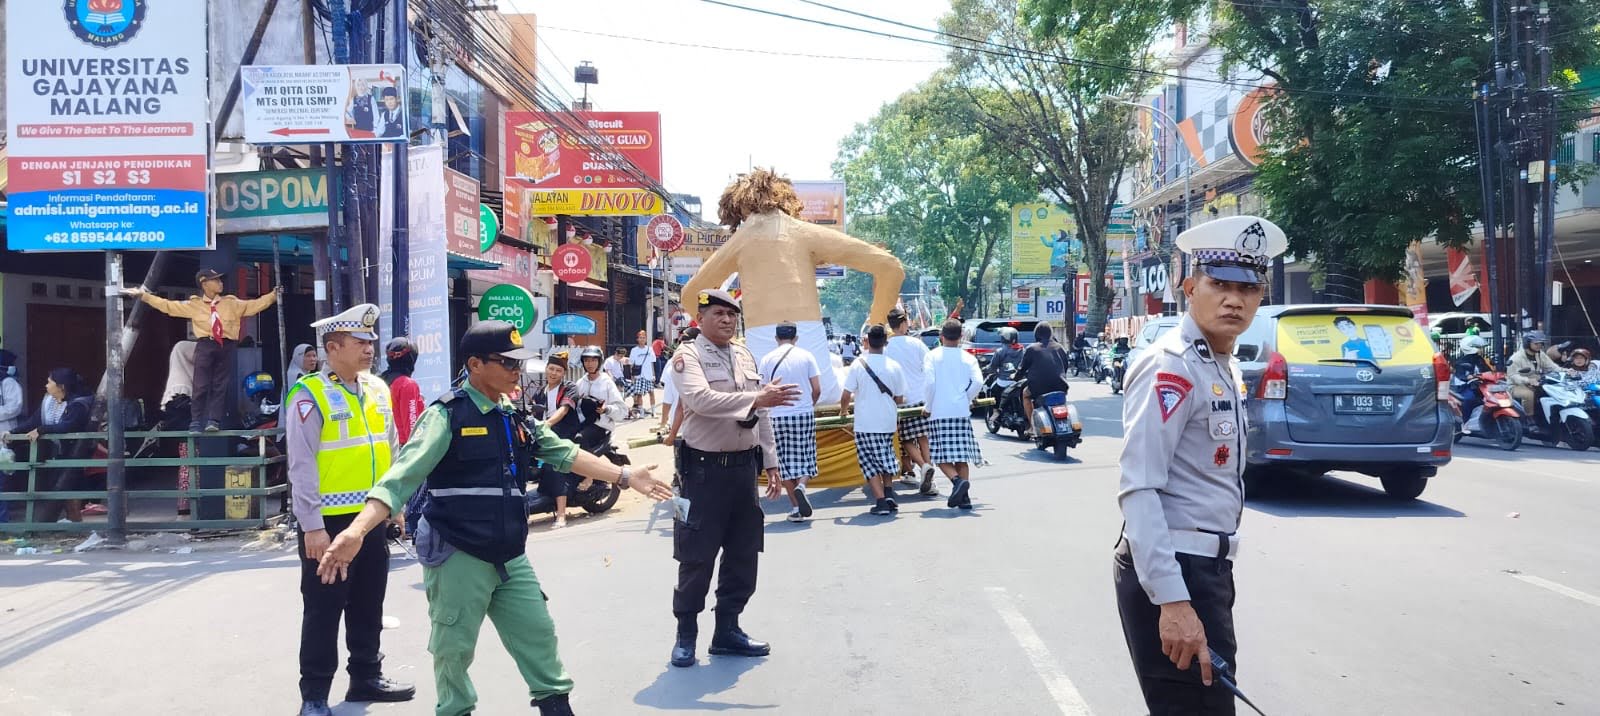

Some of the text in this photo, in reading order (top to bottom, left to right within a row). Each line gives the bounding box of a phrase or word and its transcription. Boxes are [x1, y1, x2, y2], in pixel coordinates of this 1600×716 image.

[87, 33, 125, 43] MALANG
[22, 58, 190, 76] UNIVERSITAS
[33, 77, 178, 96] GAJAYANA
[264, 86, 277, 95] MI
[280, 86, 303, 95] QITA
[50, 97, 161, 116] MALANG
[256, 98, 278, 107] MTs
[281, 97, 303, 107] QITA
[588, 120, 623, 129] Biscuit
[21, 125, 187, 136] We Give The Best To The Learners
[617, 135, 647, 145] GUAN
[21, 160, 192, 170] DENGAN JENJANG PENDIDIKAN
[62, 170, 151, 185] S1 S2 S3
[48, 193, 156, 203] Informasi Pendaftaran:
[218, 175, 328, 212] OSPOM
[580, 192, 656, 211] DINOYO
[14, 202, 198, 218] admisi.unigamalang.ac.id
[70, 220, 135, 231] Whatsapp ke:
[44, 233, 69, 243] +62
[558, 267, 587, 277] gofood
[488, 303, 523, 317] Grab
[1336, 396, 1343, 406] N
[1352, 396, 1373, 406] 1033
